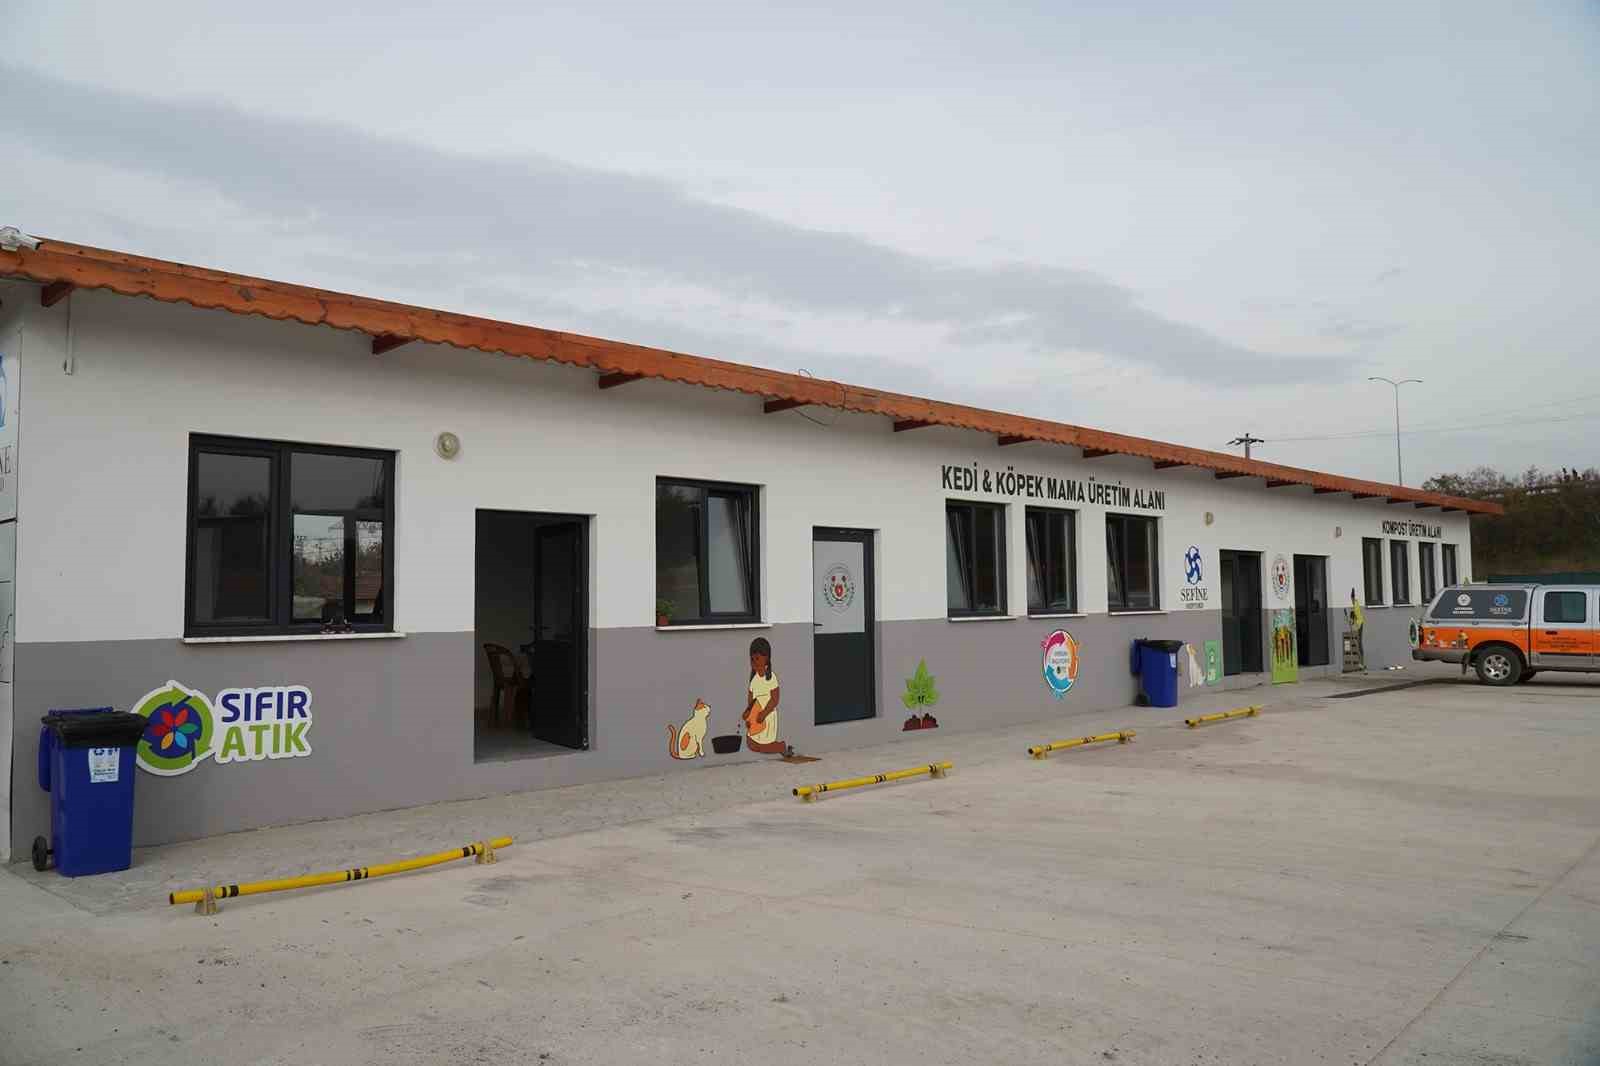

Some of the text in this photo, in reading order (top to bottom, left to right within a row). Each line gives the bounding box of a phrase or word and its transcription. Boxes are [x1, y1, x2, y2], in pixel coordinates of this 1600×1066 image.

[942, 462, 1165, 510] KEDİ & KÖPEK MAMA ÜRETİM ALANI
[221, 691, 307, 723] SIFIR
[220, 722, 306, 758] ATIK
